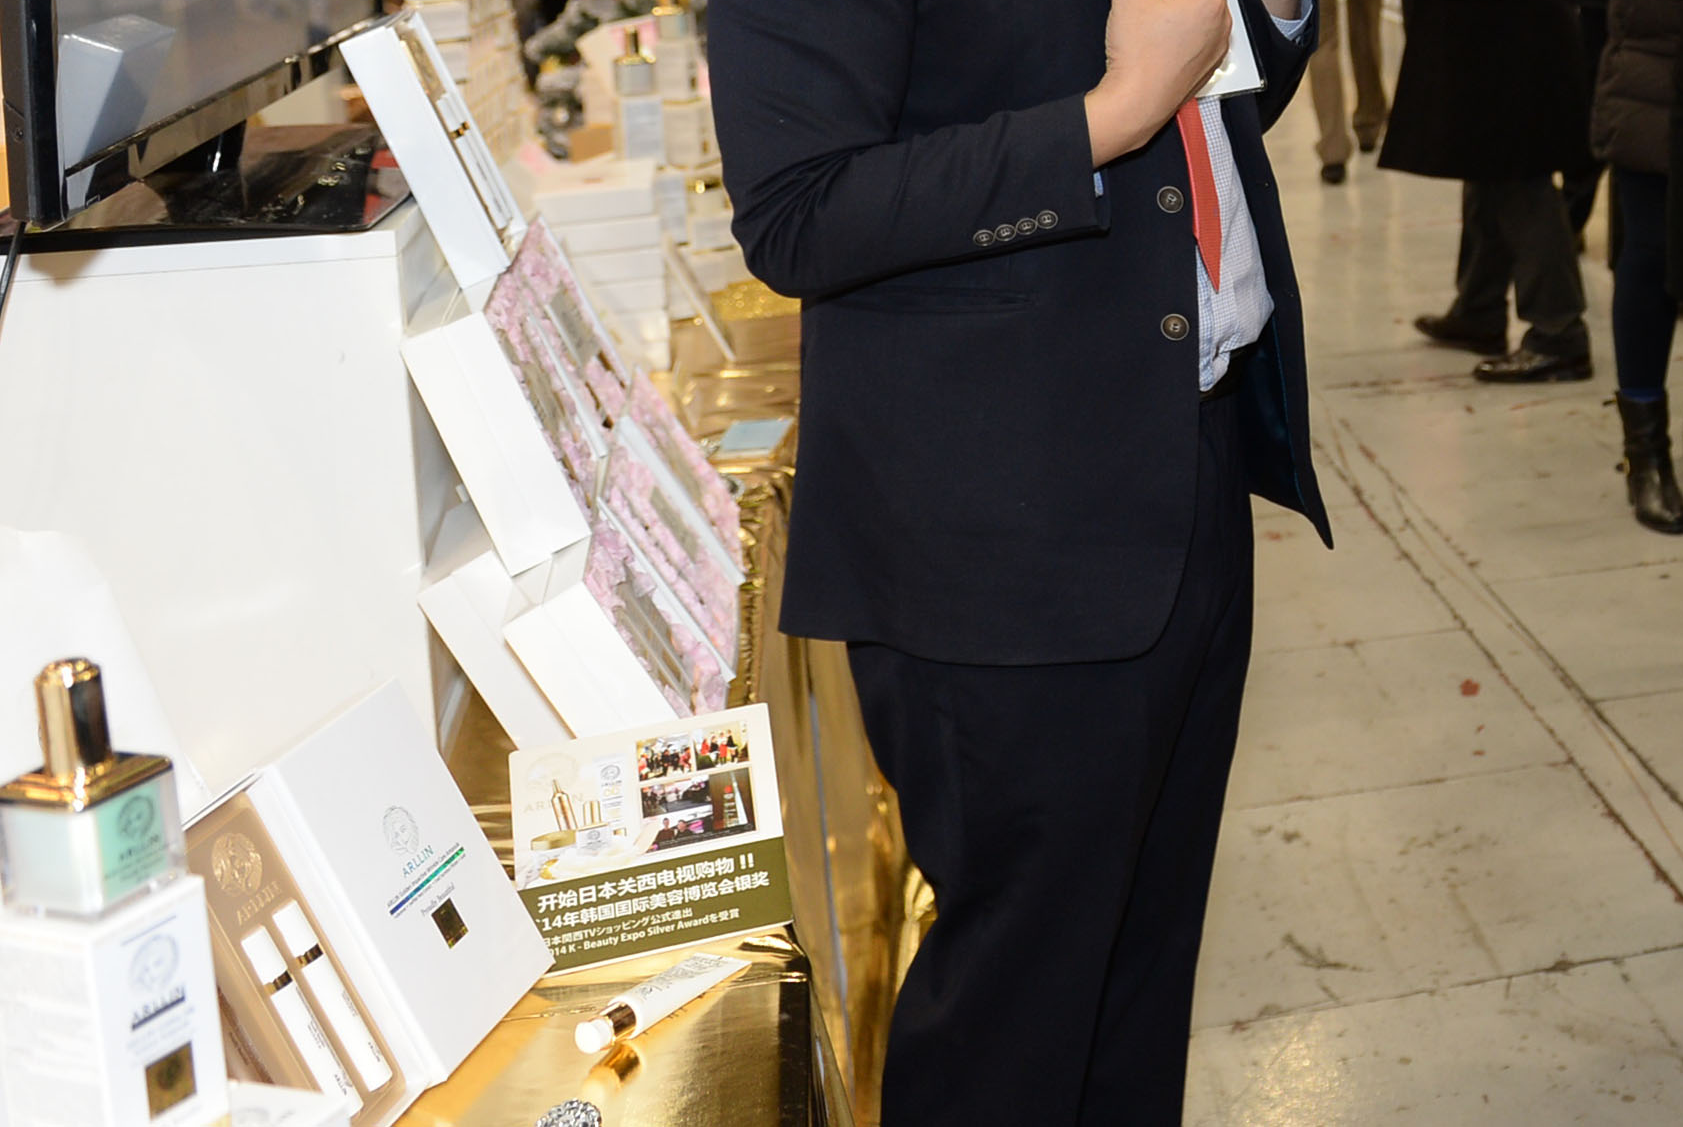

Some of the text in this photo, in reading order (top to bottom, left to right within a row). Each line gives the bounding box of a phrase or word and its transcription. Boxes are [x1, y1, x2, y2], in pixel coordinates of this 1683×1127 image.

[402, 844, 435, 878] ARLLIN
[537, 857, 735, 914] 开始日本关西电视购物
[584, 936, 620, 952] Beauty
[620, 929, 646, 945] Expo
[647, 923, 676, 938] Silver
